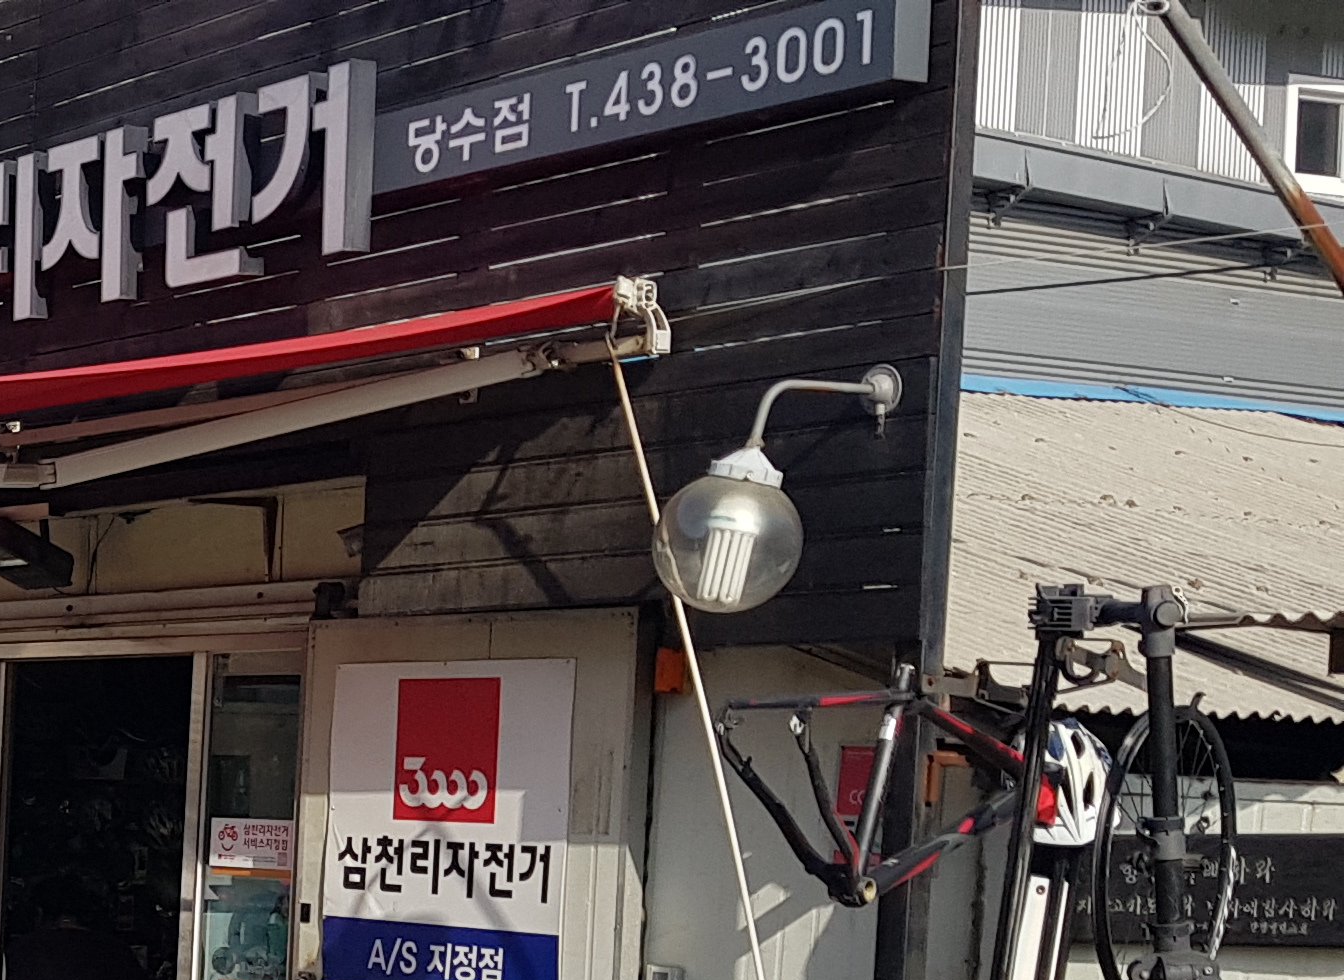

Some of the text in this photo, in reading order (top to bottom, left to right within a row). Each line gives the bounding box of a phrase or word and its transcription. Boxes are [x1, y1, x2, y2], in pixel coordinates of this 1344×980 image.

[407, 8, 875, 174] 당수점 T.438-3001
[243, 823, 289, 837] 삼천리자전거
[243, 838, 288, 851] 서비스지정점
[338, 835, 552, 904] 삼천리자전거
[367, 937, 418, 975] A/S
